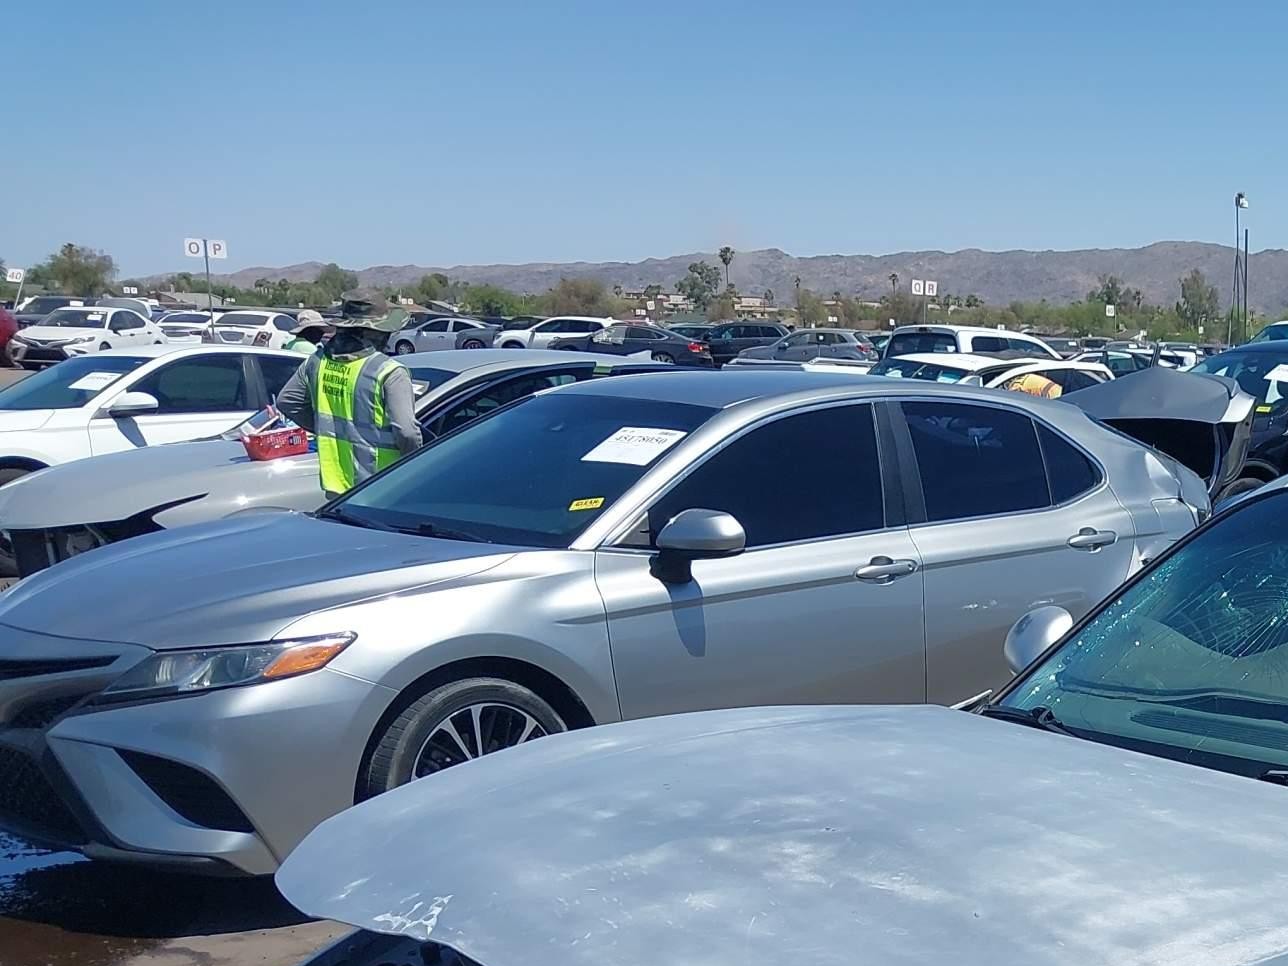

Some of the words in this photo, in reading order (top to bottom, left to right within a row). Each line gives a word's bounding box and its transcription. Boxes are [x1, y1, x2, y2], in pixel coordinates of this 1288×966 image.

[188, 242, 199, 254] O
[213, 244, 222, 255] P
[8, 271, 21, 281] 40
[928, 285, 935, 295] R
